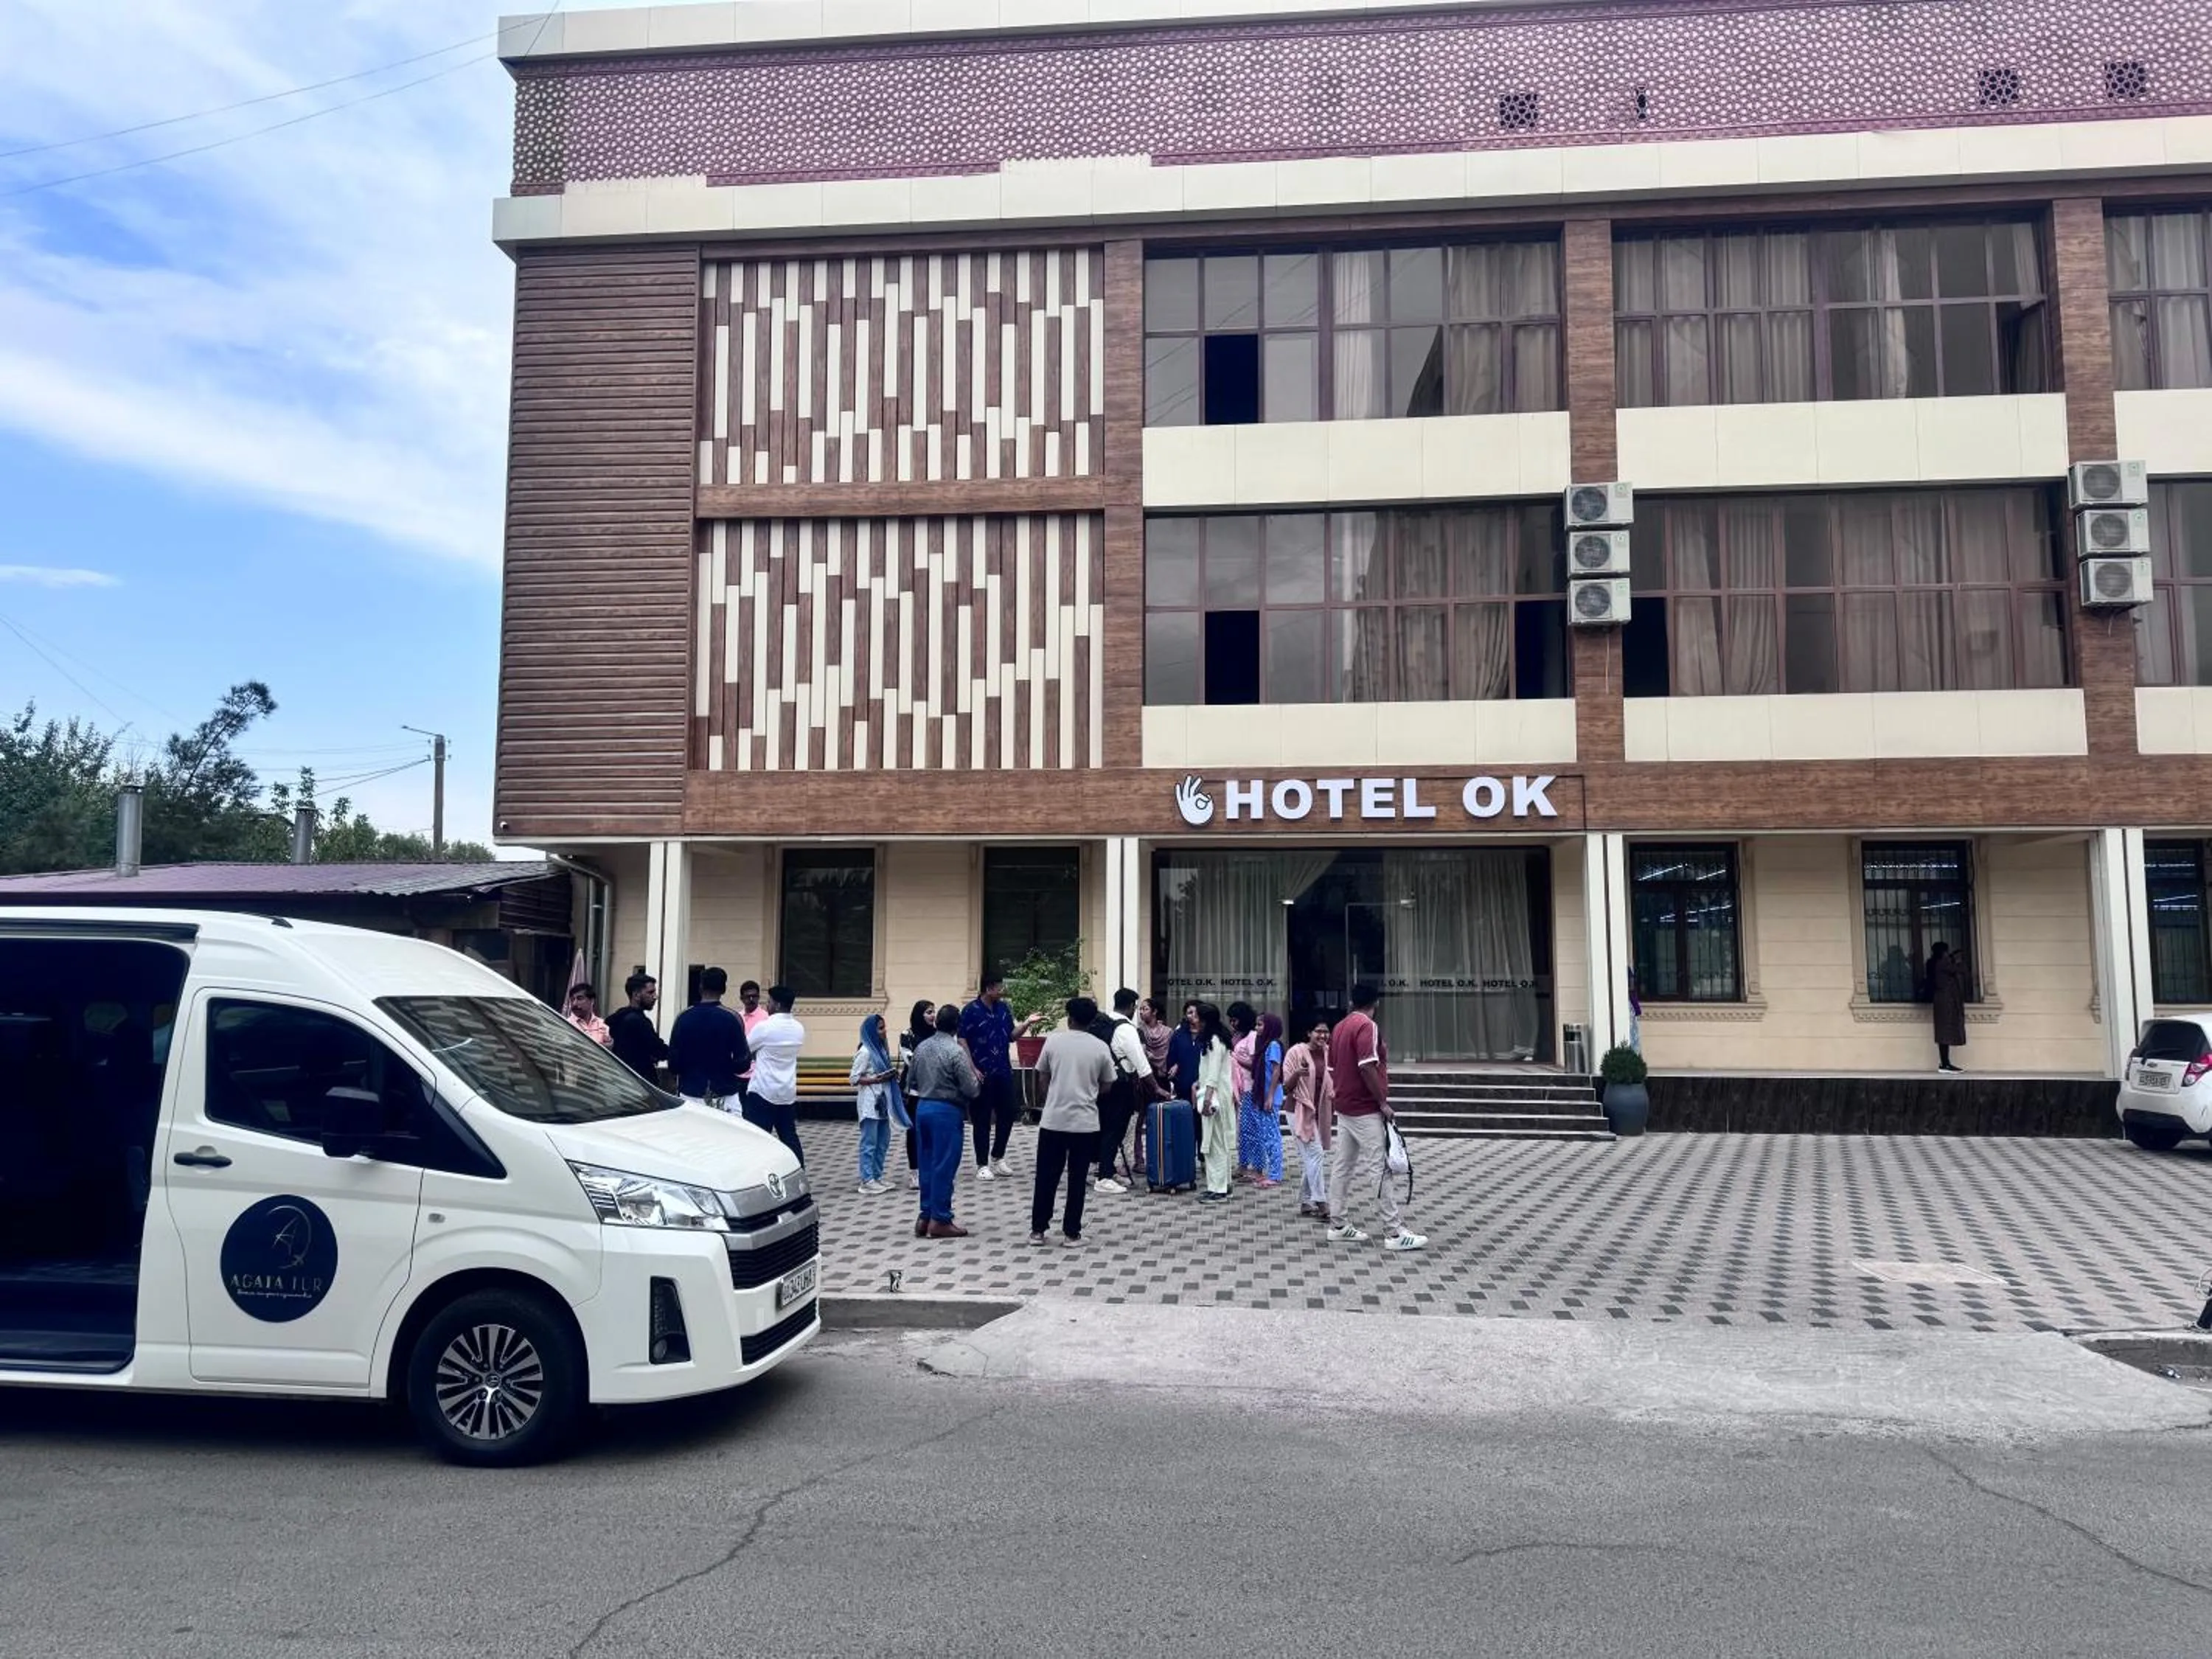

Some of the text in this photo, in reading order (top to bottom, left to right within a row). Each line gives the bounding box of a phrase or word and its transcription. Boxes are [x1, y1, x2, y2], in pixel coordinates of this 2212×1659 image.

[1225, 775, 1558, 820] HOTEL OK
[1256, 978, 1276, 987] O.K.
[1419, 979, 1453, 987] HOTEL
[1483, 979, 1517, 987] HOTEL
